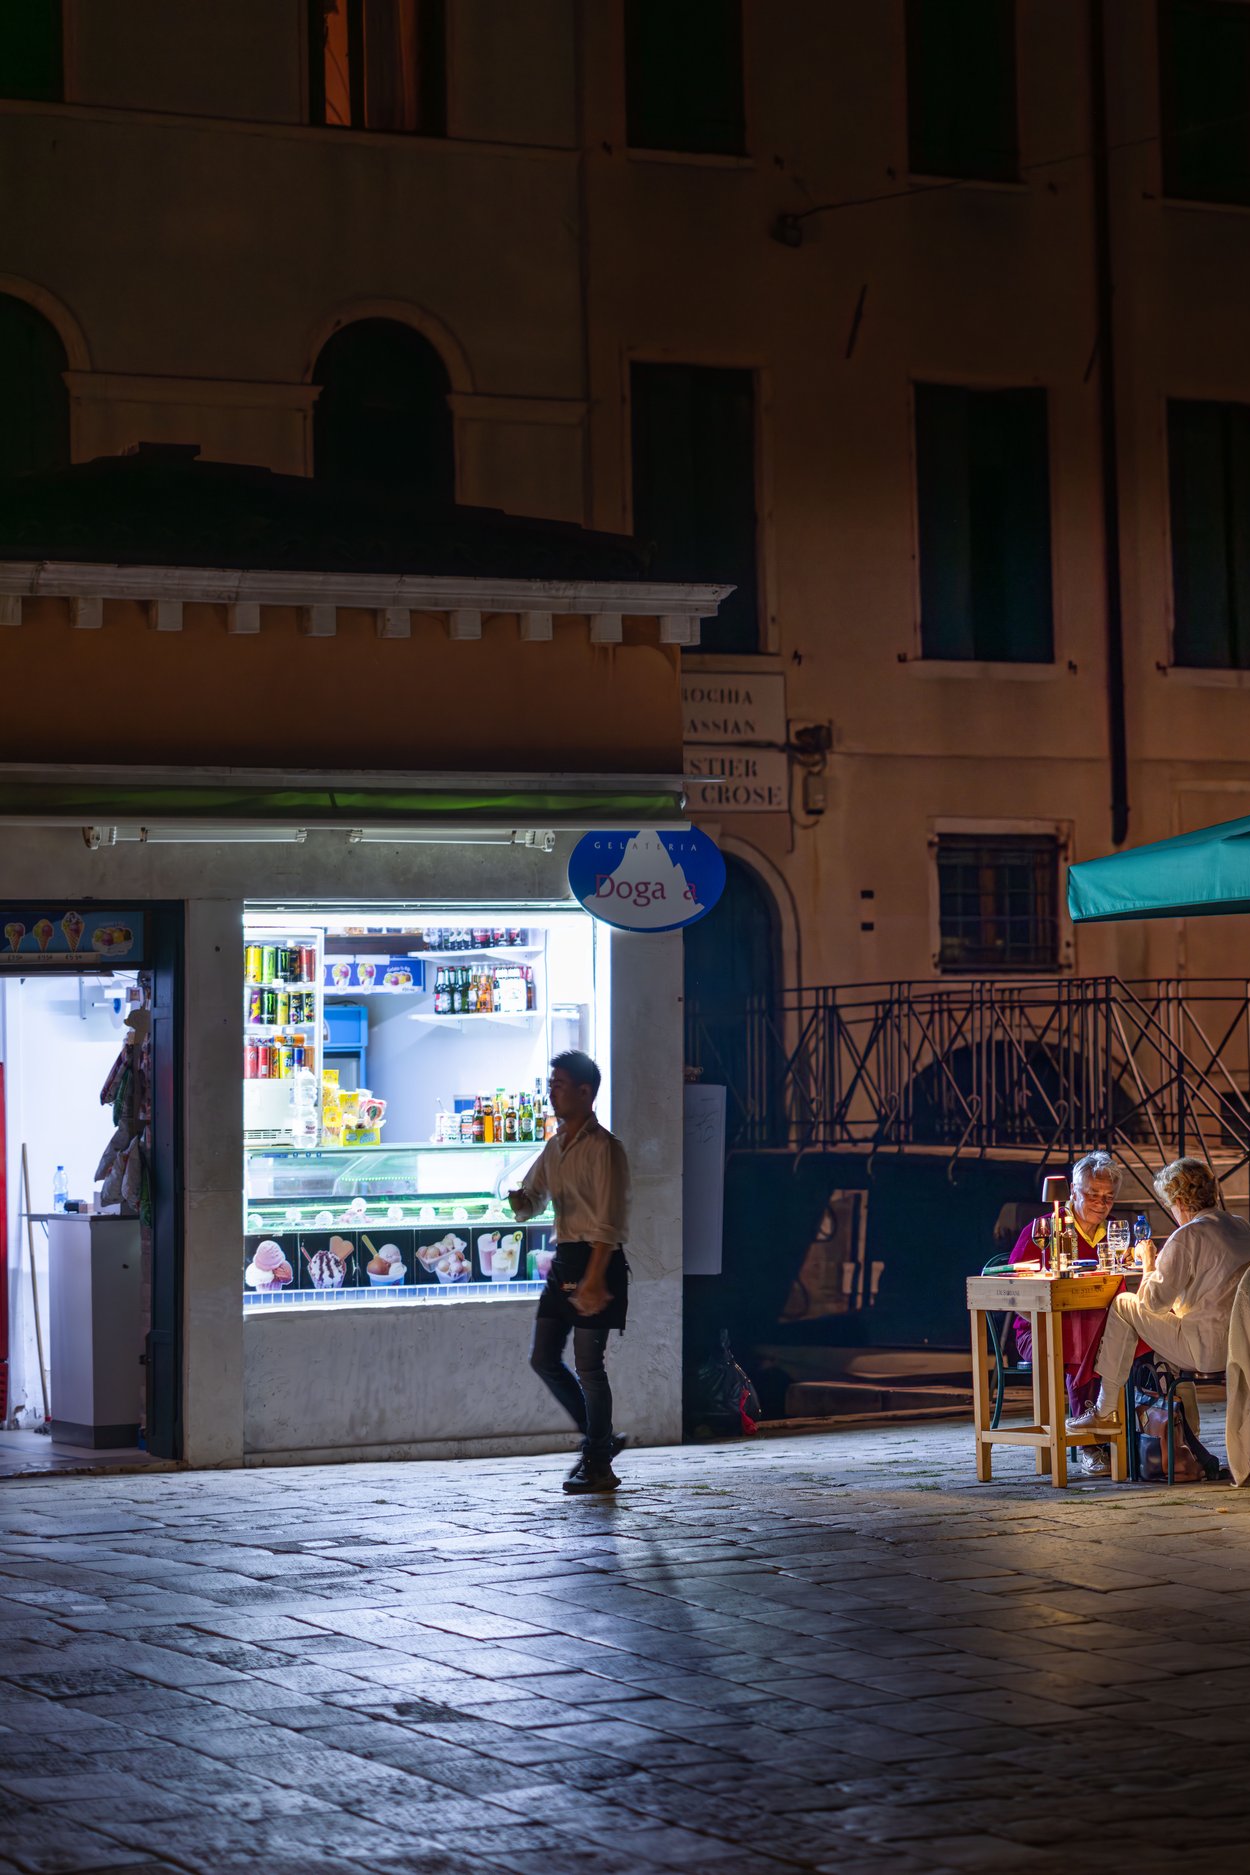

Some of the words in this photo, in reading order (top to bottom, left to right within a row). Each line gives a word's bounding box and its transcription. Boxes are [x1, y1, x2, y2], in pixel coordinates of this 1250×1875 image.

[684, 756, 758, 778] STIER
[701, 785, 783, 806] CROSE
[594, 841, 697, 852] GELATERIA
